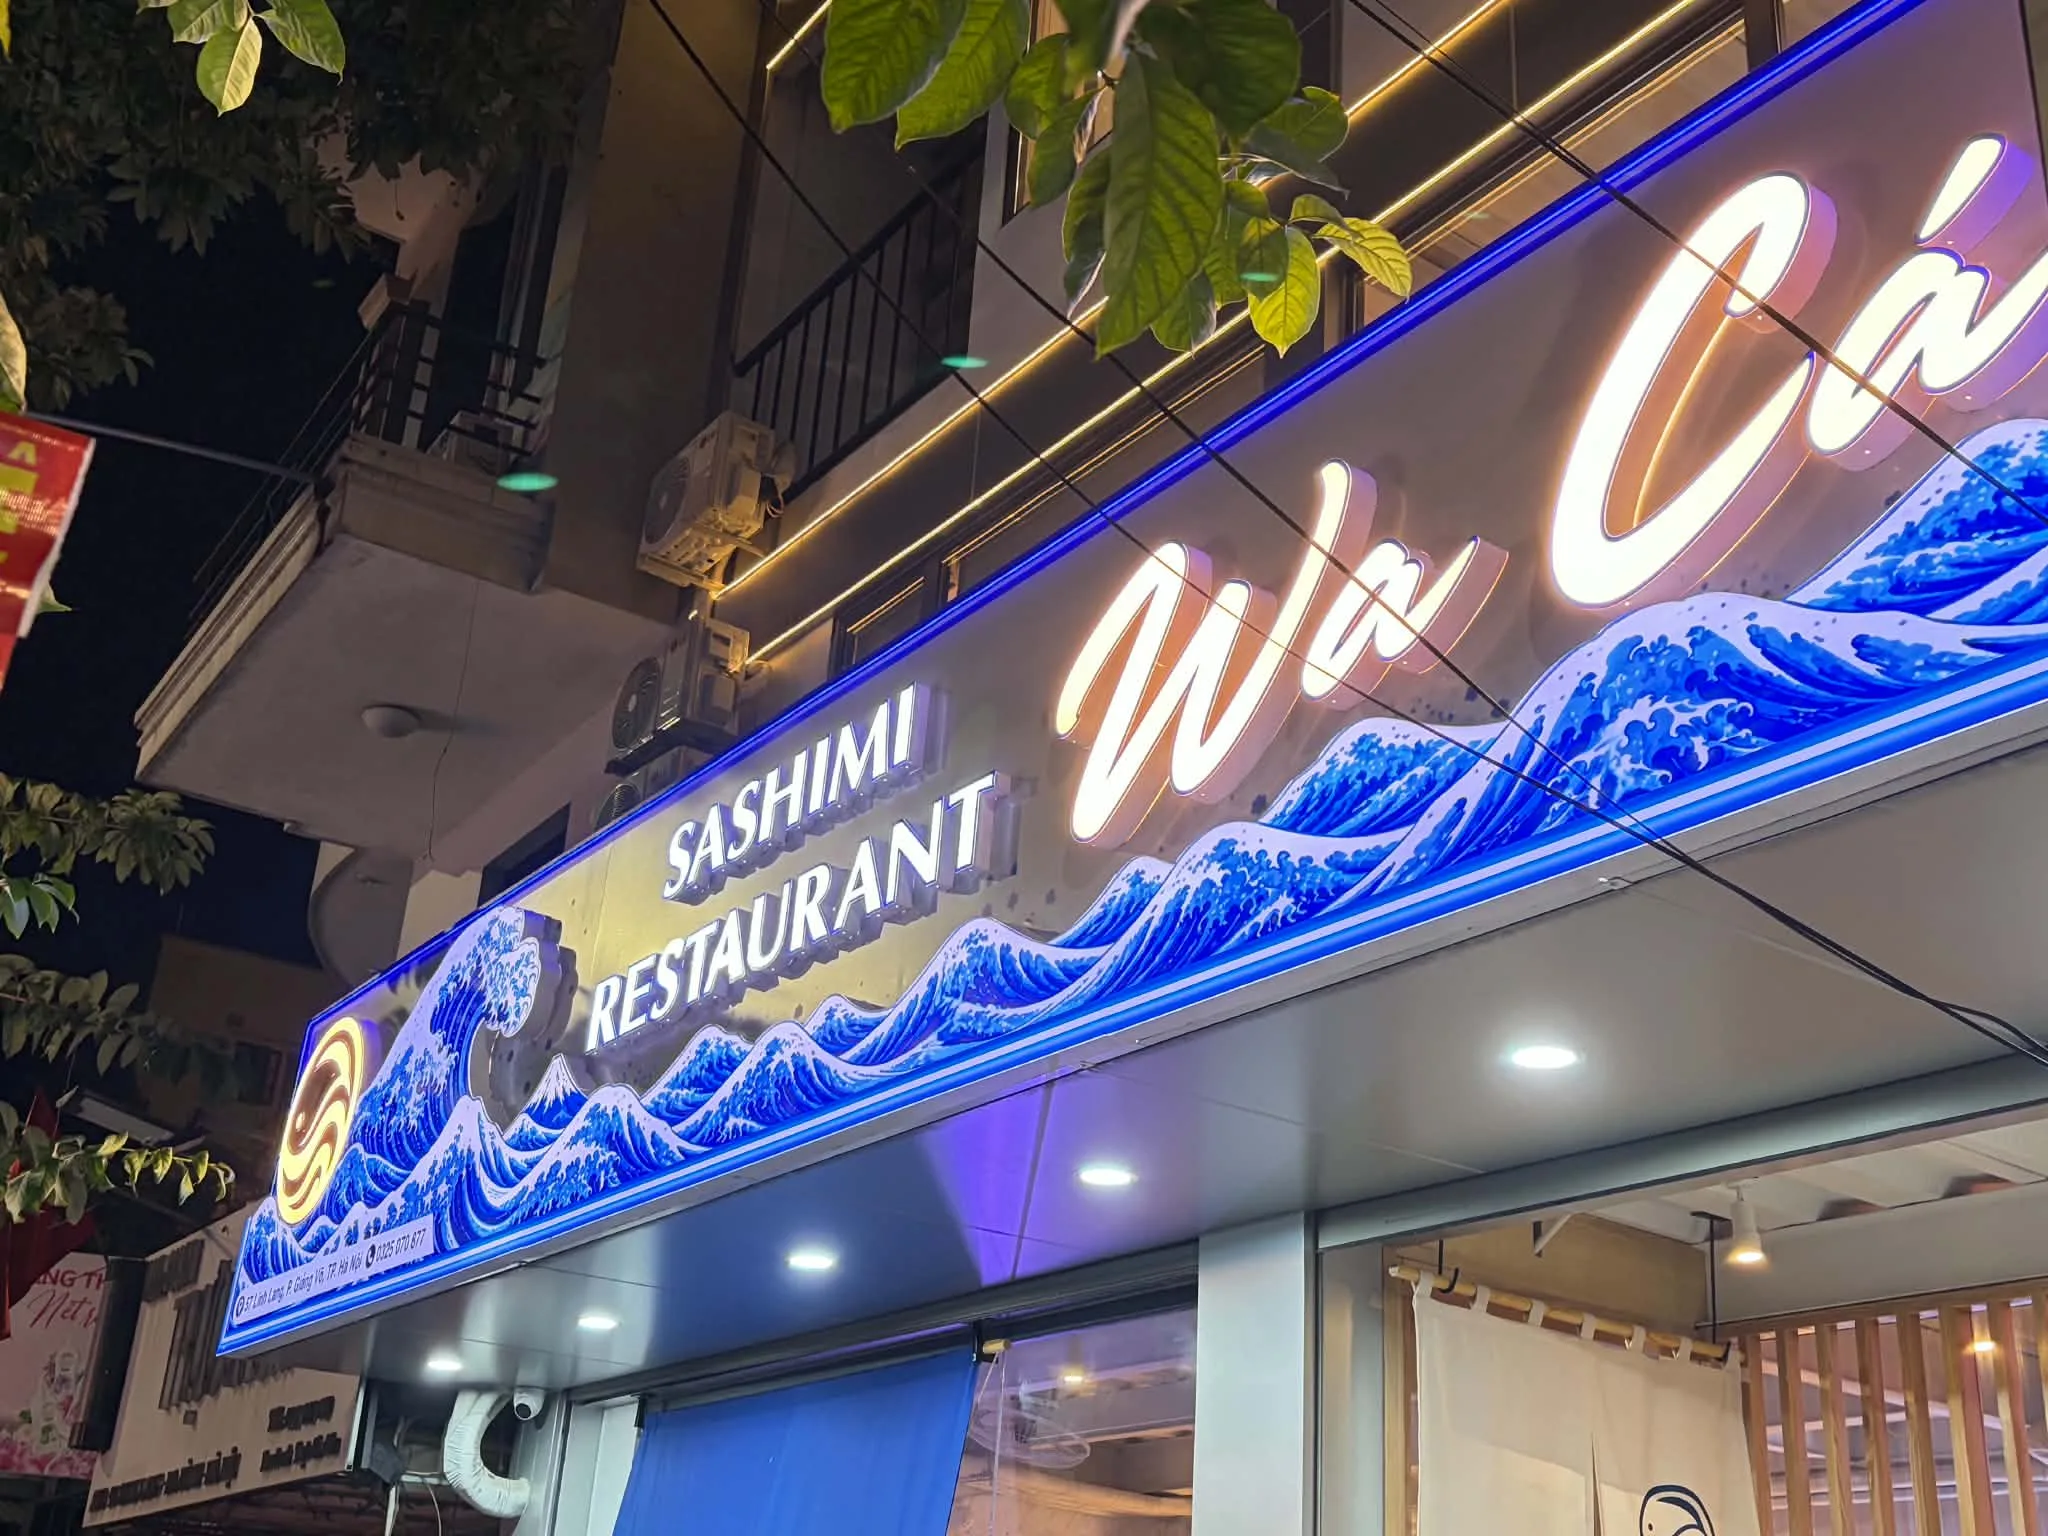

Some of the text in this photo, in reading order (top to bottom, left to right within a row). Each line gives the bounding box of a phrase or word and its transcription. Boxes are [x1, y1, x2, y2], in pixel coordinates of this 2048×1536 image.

[1055, 133, 2048, 843] Wa Cá
[585, 770, 997, 1054] RESTAURANT
[663, 681, 919, 900] SASHIMI
